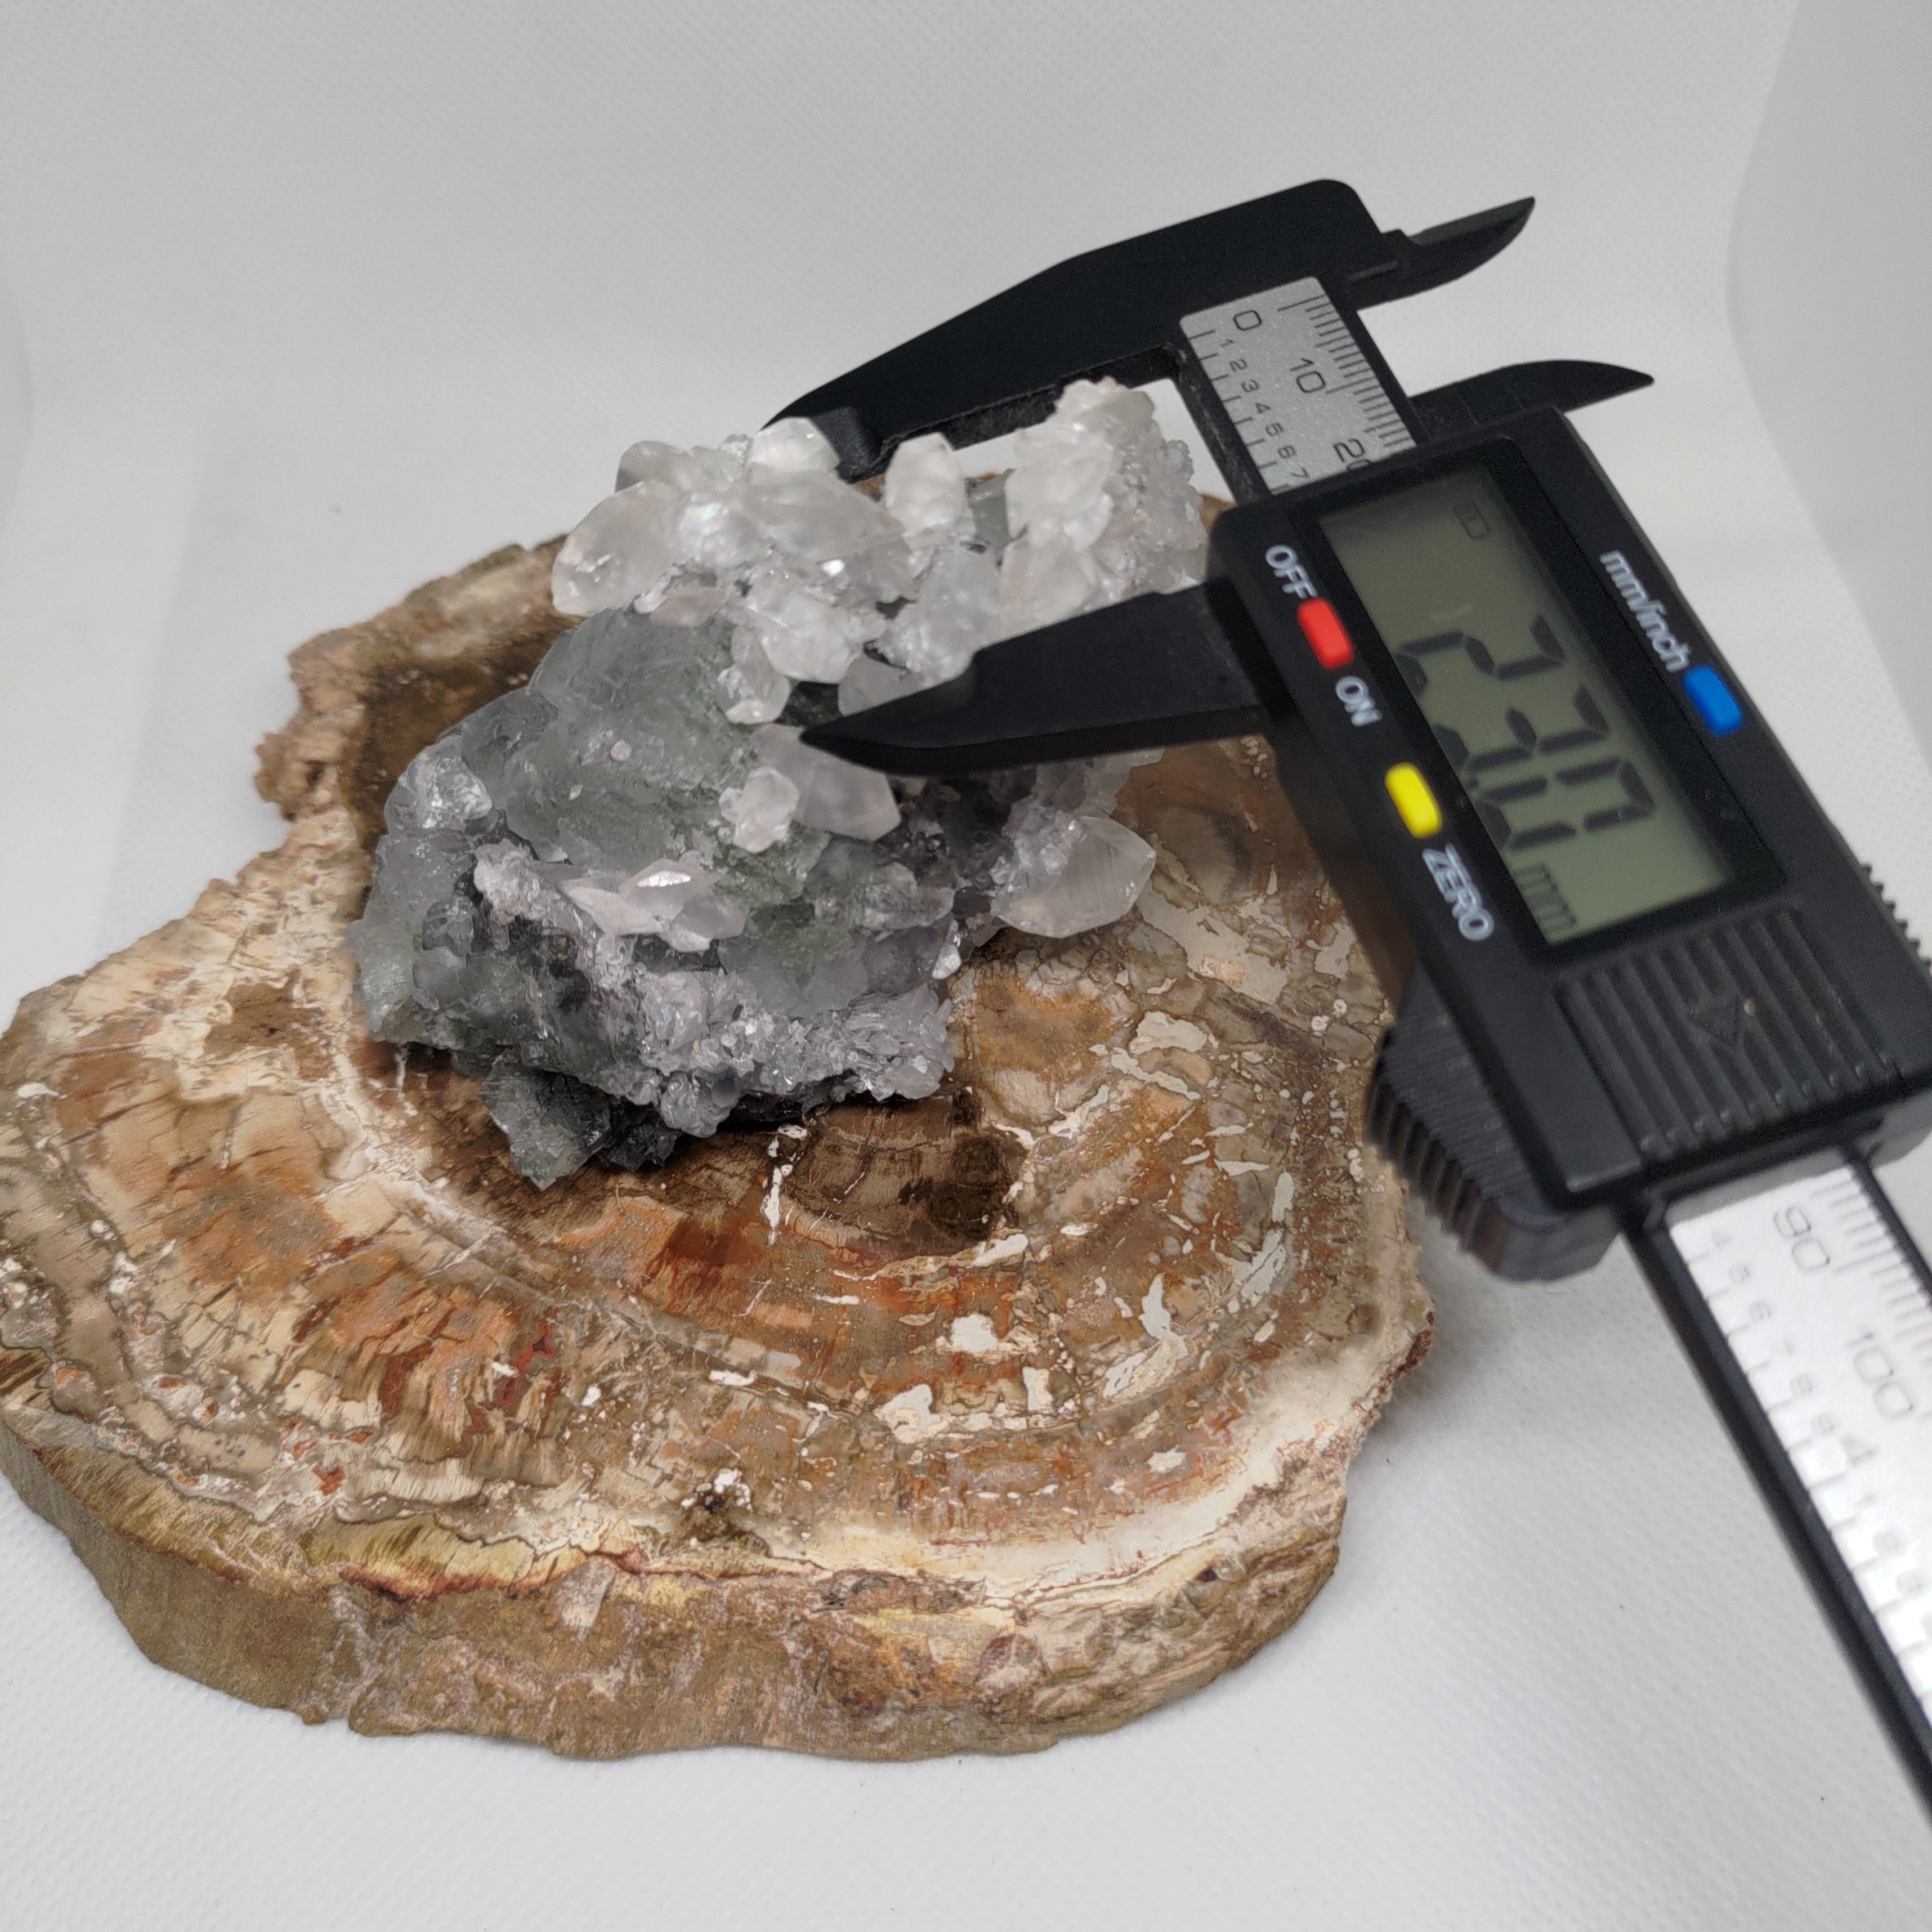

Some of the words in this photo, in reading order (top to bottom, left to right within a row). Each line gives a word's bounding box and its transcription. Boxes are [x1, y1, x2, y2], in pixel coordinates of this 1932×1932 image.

[1220, 339, 1233, 347] 1
[1229, 359, 1247, 372] 2
[1241, 379, 1259, 392] 3
[1254, 402, 1271, 414] 4
[1265, 422, 1283, 436] 5
[1277, 445, 1296, 459] 6
[1291, 467, 1309, 480] 7
[1233, 310, 1262, 331] 0
[1289, 357, 1326, 393] 10
[1265, 544, 1317, 600] OFF
[1335, 676, 1382, 727] ON
[1599, 550, 1690, 672] mm/inch
[1421, 844, 1493, 941] ZERO
[1515, 863, 1577, 933] mm
[1774, 1206, 1832, 1272] 90
[1845, 1330, 1915, 1421] 100
